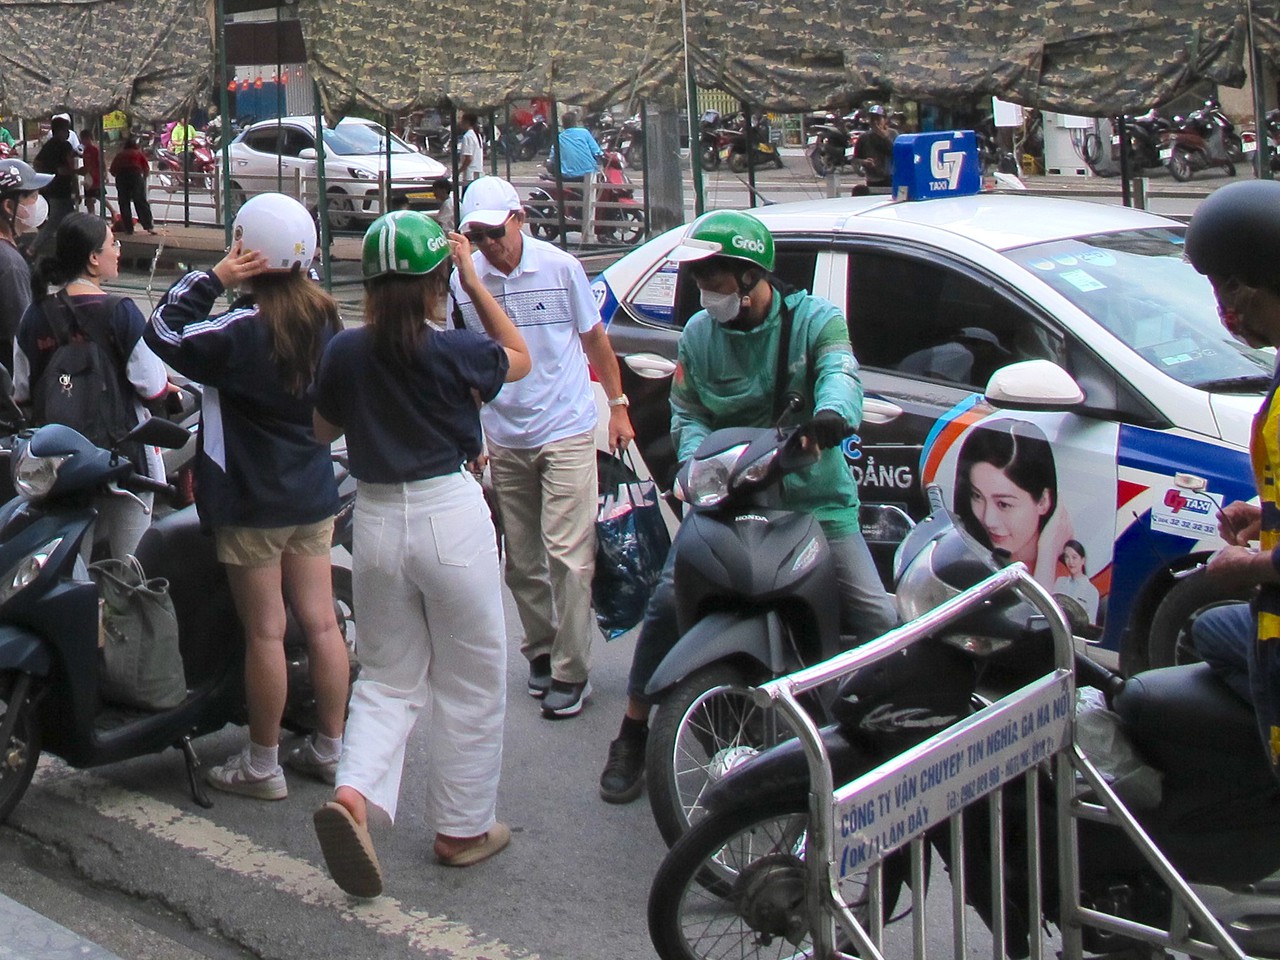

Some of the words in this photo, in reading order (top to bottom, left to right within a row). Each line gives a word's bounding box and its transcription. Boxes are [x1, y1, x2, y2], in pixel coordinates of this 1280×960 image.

[930, 140, 967, 190] G7
[929, 180, 947, 191] TAXI
[732, 235, 765, 253] Grab
[1186, 499, 1211, 511] TAXI
[841, 800, 875, 838] CÔNG
[878, 790, 891, 817] TY
[1021, 712, 1034, 738] GA
